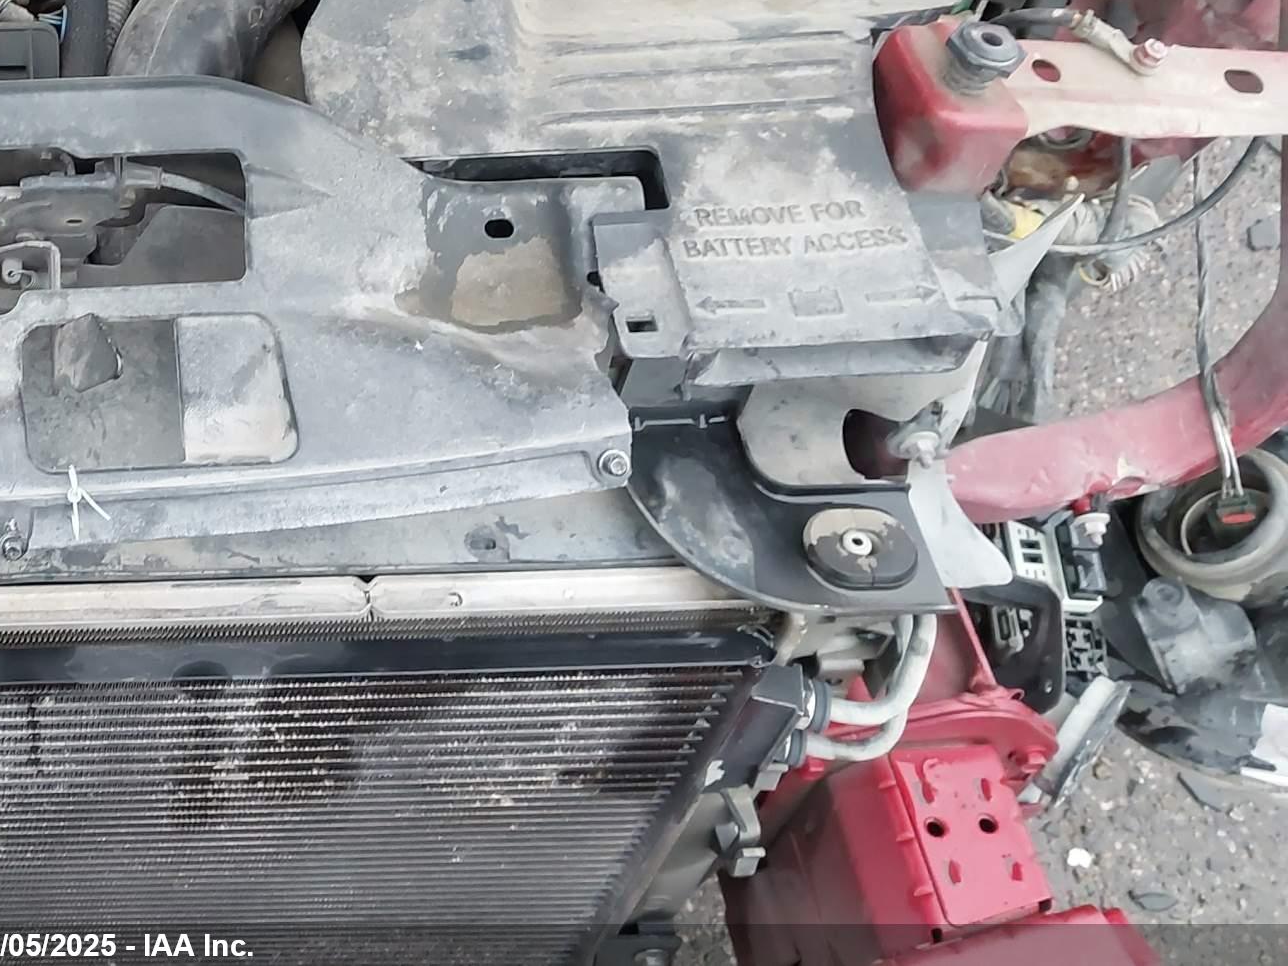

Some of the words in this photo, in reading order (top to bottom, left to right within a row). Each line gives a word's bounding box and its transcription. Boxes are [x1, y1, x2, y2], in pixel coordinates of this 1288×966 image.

[694, 204, 806, 227] REMOVE
[810, 200, 866, 222] FOR
[683, 236, 792, 259] BATTERY
[803, 226, 909, 254] ACCESS
